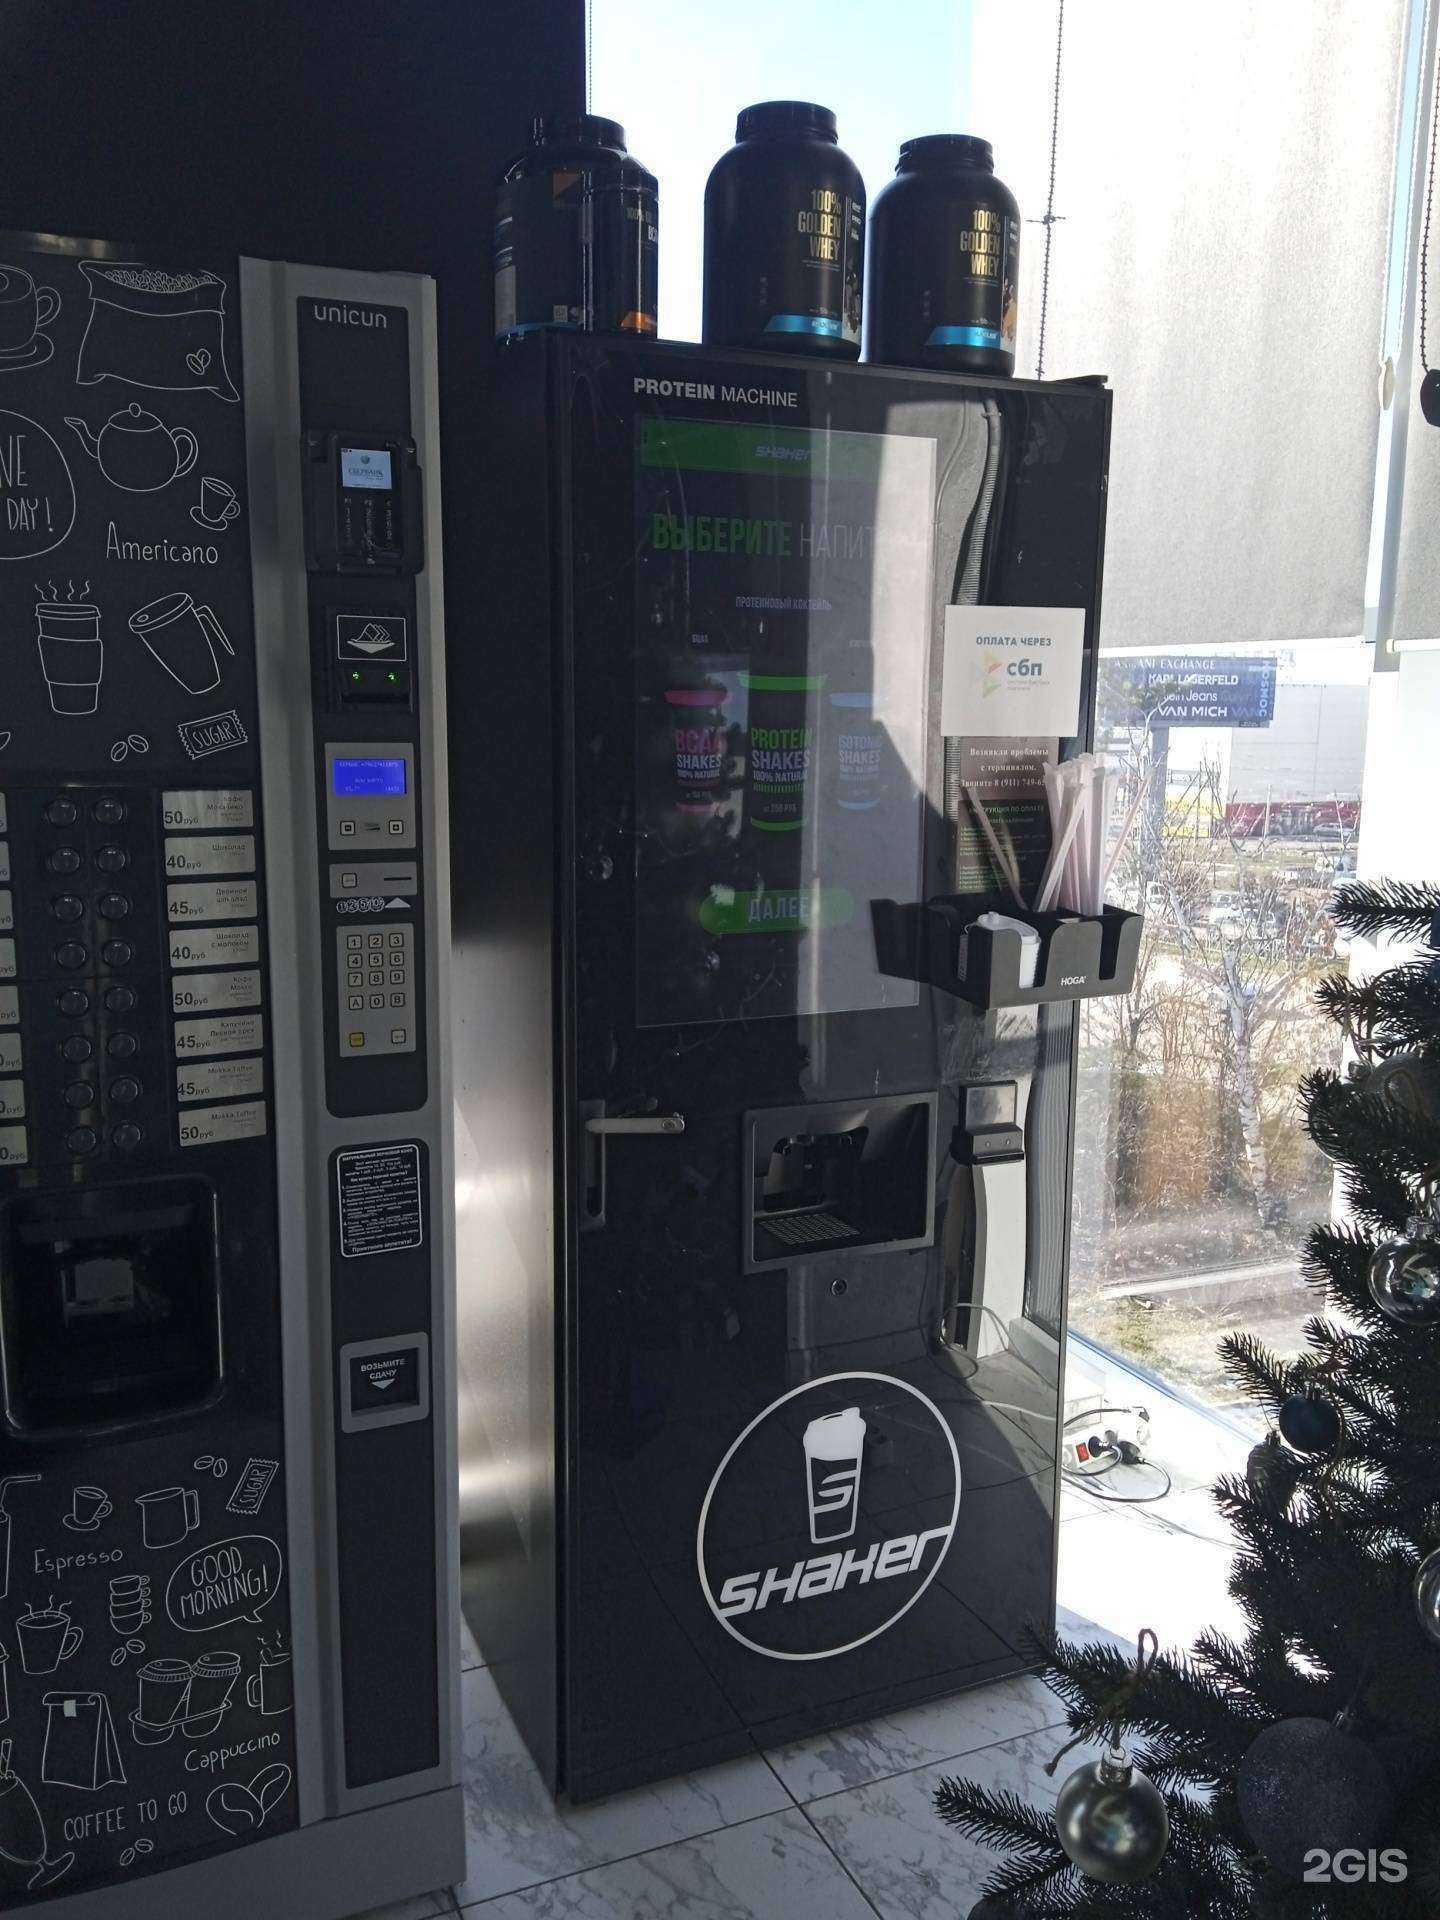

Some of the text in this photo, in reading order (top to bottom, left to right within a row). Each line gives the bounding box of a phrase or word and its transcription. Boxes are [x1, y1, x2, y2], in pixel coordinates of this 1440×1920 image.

[811, 189, 842, 214] 100%
[798, 211, 842, 238] GOLDEN
[973, 209, 1000, 233] 100%
[810, 236, 840, 260] WHEY
[960, 230, 1000, 255] GOLDEN
[971, 254, 1000, 277] WHEY
[314, 304, 387, 328] unicun
[633, 377, 798, 408] PROTEIN MACHINE
[106, 521, 218, 564] Americano
[653, 513, 793, 556] ВЫБЕРИТЕ
[976, 636, 1052, 647] ОПЛАТА ЧЕРЕЗ
[1007, 658, 1042, 676] сбп
[1160, 659, 1217, 670] EXCHANGE
[1178, 674, 1239, 685] LAGERFELD
[1186, 691, 1218, 702] Jeans
[1158, 706, 1187, 717] VAN
[1192, 706, 1228, 717] MICH
[192, 721, 236, 749] SUGAR
[750, 728, 814, 750] PROTEIN
[677, 754, 721, 769] SHAKES
[751, 750, 811, 770] SHAKES
[753, 769, 774, 783] 100%
[748, 896, 810, 922] ДАЛЕЕ
[1061, 976, 1085, 987] HOGA
[360, 1358, 408, 1372] ВОЗЬМИТЕ
[369, 1369, 397, 1379] СДАЧУ
[239, 1469, 269, 1503] SUGAR
[34, 1549, 124, 1579] Espresso
[191, 1546, 242, 1587] GOOD
[180, 1564, 270, 1619] MORNING!
[184, 1733, 281, 1773] Cappuccino
[64, 1791, 187, 1841] COFFEE TO GO
